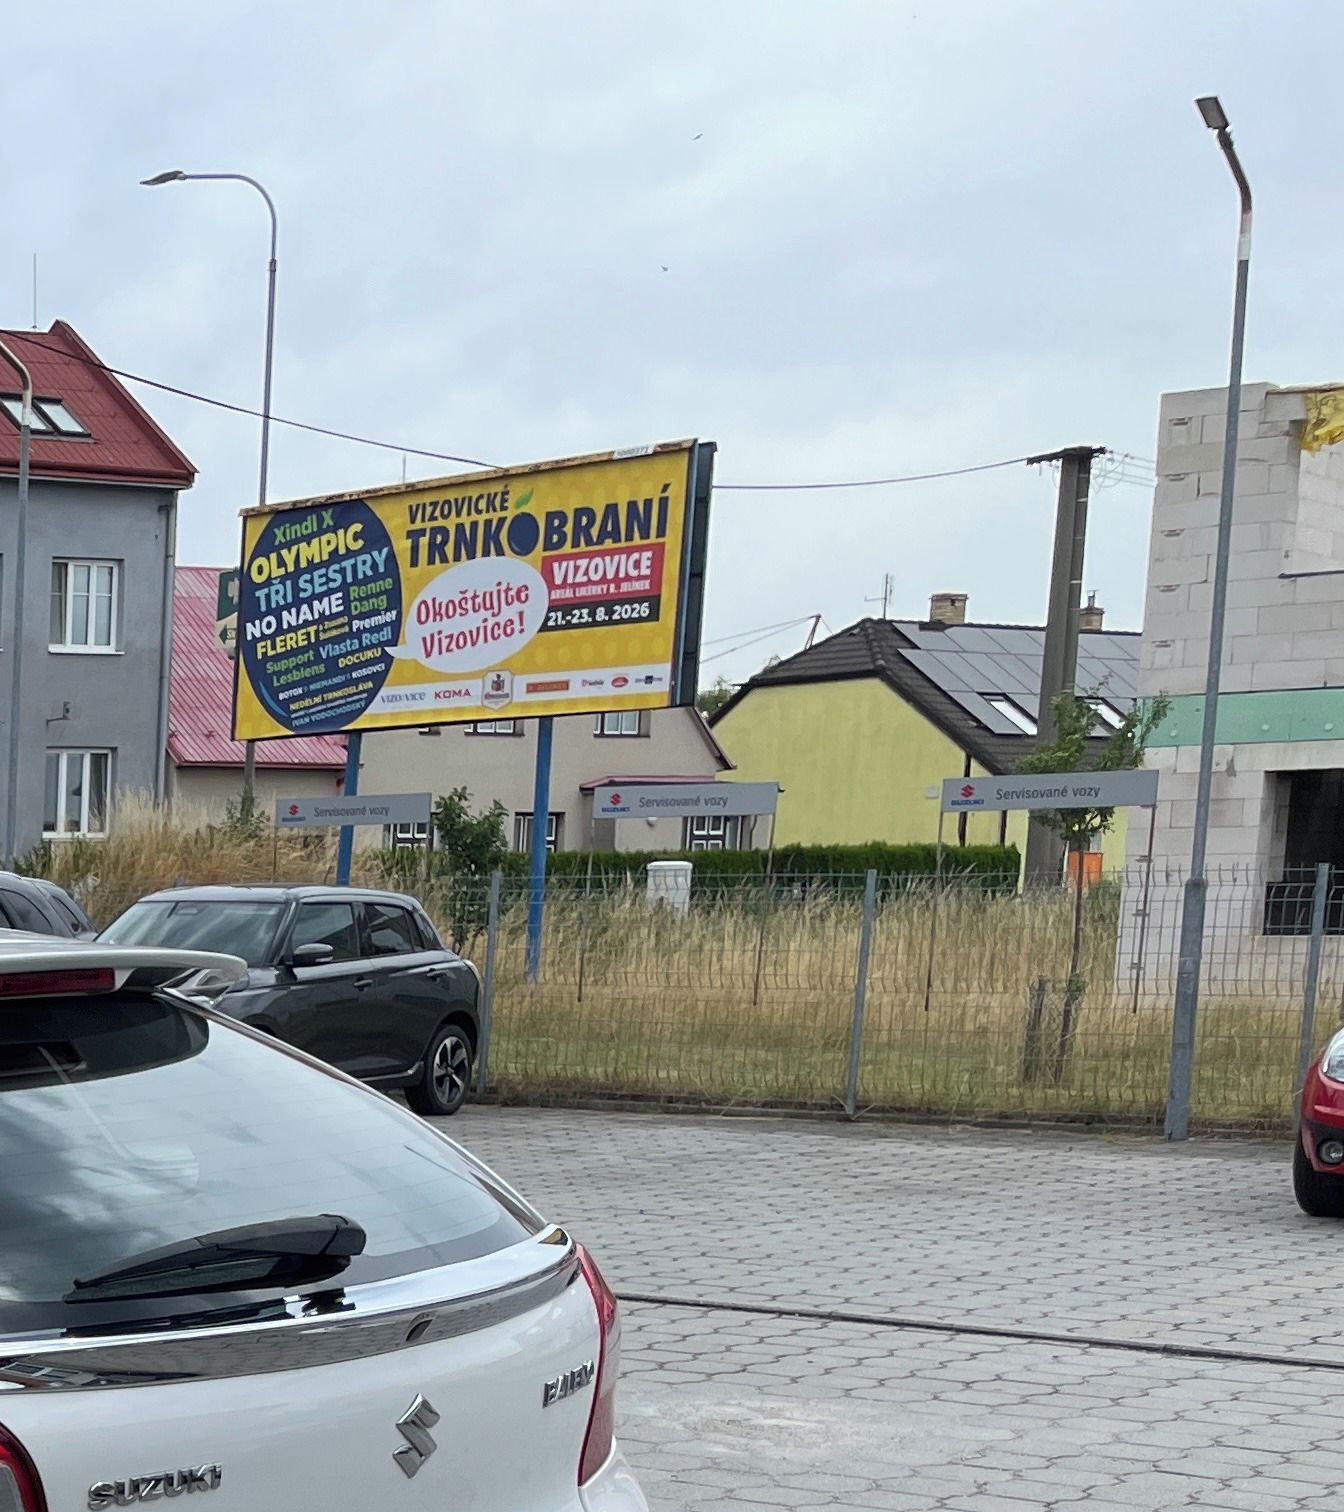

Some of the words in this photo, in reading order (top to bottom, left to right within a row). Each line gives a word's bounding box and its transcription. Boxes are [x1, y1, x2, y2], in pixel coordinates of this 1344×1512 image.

[408, 484, 510, 524] VIZOVICKÉ
[274, 515, 317, 545] Xindl
[321, 508, 334, 528] X
[250, 523, 365, 583] OLYMPIC
[255, 578, 293, 612] TŘI
[298, 547, 389, 598] SESTRY
[552, 551, 652, 585] VIZOVICE
[349, 578, 393, 598] Renne
[246, 615, 277, 640] NO
[282, 592, 344, 629] NAME
[351, 595, 387, 615] Dang
[416, 581, 529, 625] Okoštujte
[547, 608, 592, 626] 21.-23.
[595, 607, 609, 621] 8.
[612, 602, 650, 620] 2026
[352, 609, 397, 632] Premier
[421, 610, 525, 658] Vizovice!
[256, 625, 318, 660] FLERET
[319, 637, 360, 659] Vlasta
[363, 627, 392, 647] Redl
[266, 650, 314, 674] Support
[338, 647, 382, 668] DOCUKU
[272, 663, 326, 687] Lesbiens
[434, 689, 472, 700] KOMA
[638, 795, 700, 808] Servisované
[703, 796, 728, 808] vozy
[996, 786, 1067, 800] Servisované
[1072, 785, 1100, 798] vozy
[314, 806, 366, 817] Servisované
[369, 806, 390, 816] vozy
[87, 1461, 223, 1512] SUZUKI
